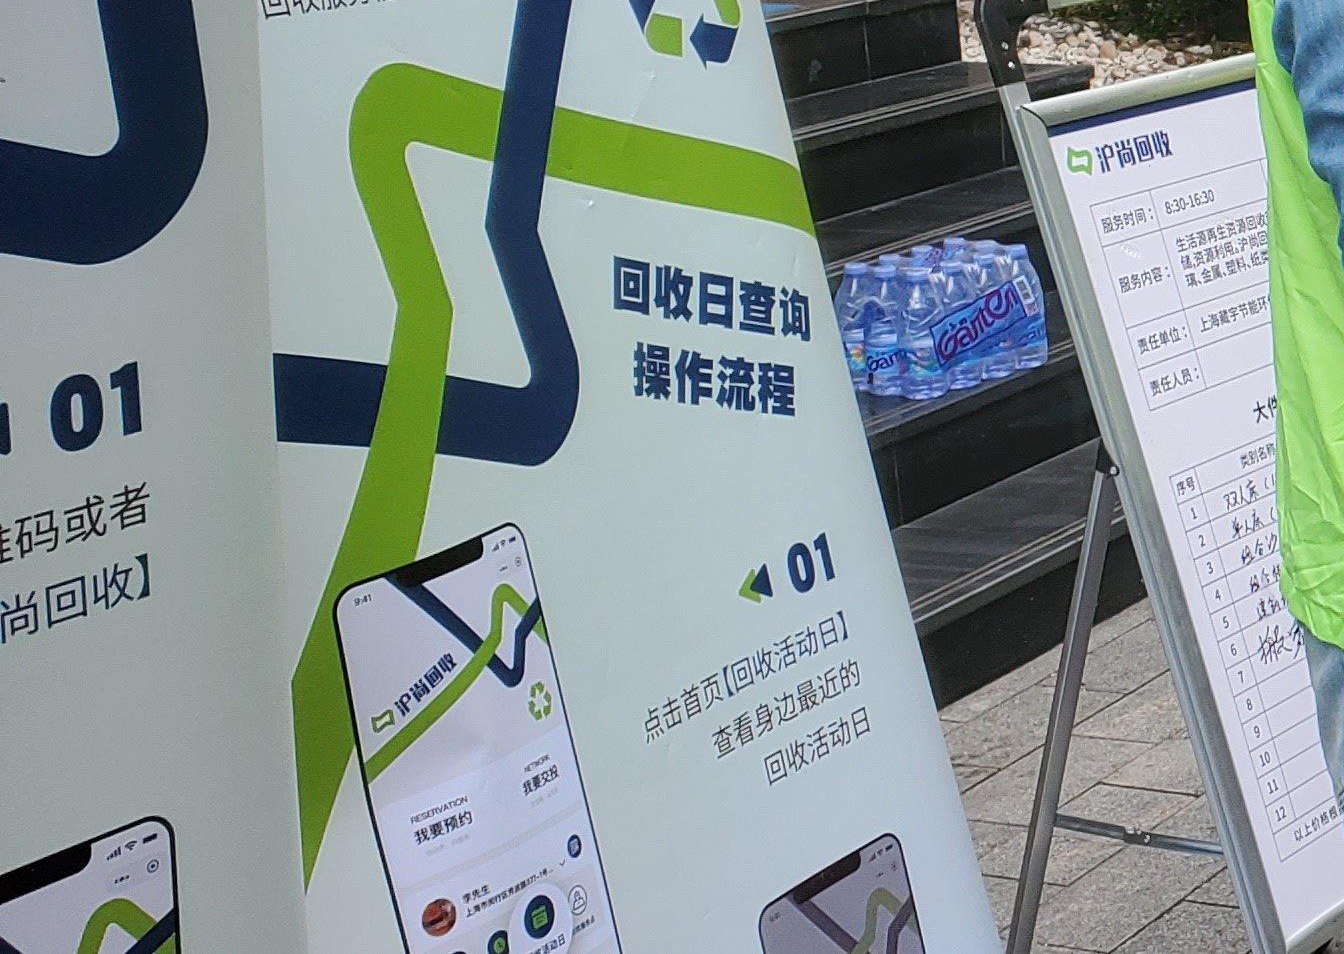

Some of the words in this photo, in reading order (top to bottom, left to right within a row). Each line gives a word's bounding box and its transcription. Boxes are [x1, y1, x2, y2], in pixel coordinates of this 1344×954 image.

[1095, 130, 1173, 173] 沪尚回收
[1164, 189, 1215, 215] 8:30-16:30
[1101, 206, 1154, 234] 服务时间：
[1118, 266, 1171, 293] 服务内容：
[613, 254, 811, 342] 回收日查询
[1137, 327, 1188, 355] 责任单位：
[633, 341, 796, 417] 操作流程
[1149, 367, 1200, 397] 责任人员：
[49, 361, 143, 452] 01
[1176, 476, 1195, 496] 序号
[1190, 508, 1197, 520] 1
[1198, 535, 1206, 547] 2
[787, 532, 836, 593] 01
[1206, 562, 1214, 574] 3
[353, 593, 373, 607] 9:41
[1215, 589, 1221, 600] 4
[1222, 616, 1230, 629] 5
[1230, 643, 1237, 656] 6
[394, 652, 457, 718] 沪尚回收
[643, 610, 849, 744] 点击首页【回收活动日】
[1237, 671, 1244, 684] 7
[711, 659, 861, 760] 查看身边最近的
[1246, 698, 1253, 711] 8
[1253, 726, 1261, 738] 9
[763, 706, 871, 786] 回收活动日
[1259, 750, 1271, 767] 10
[1267, 778, 1279, 795] 11
[410, 796, 468, 824] RESERVATION
[1274, 806, 1287, 822] 12
[414, 811, 473, 845] 我要预约
